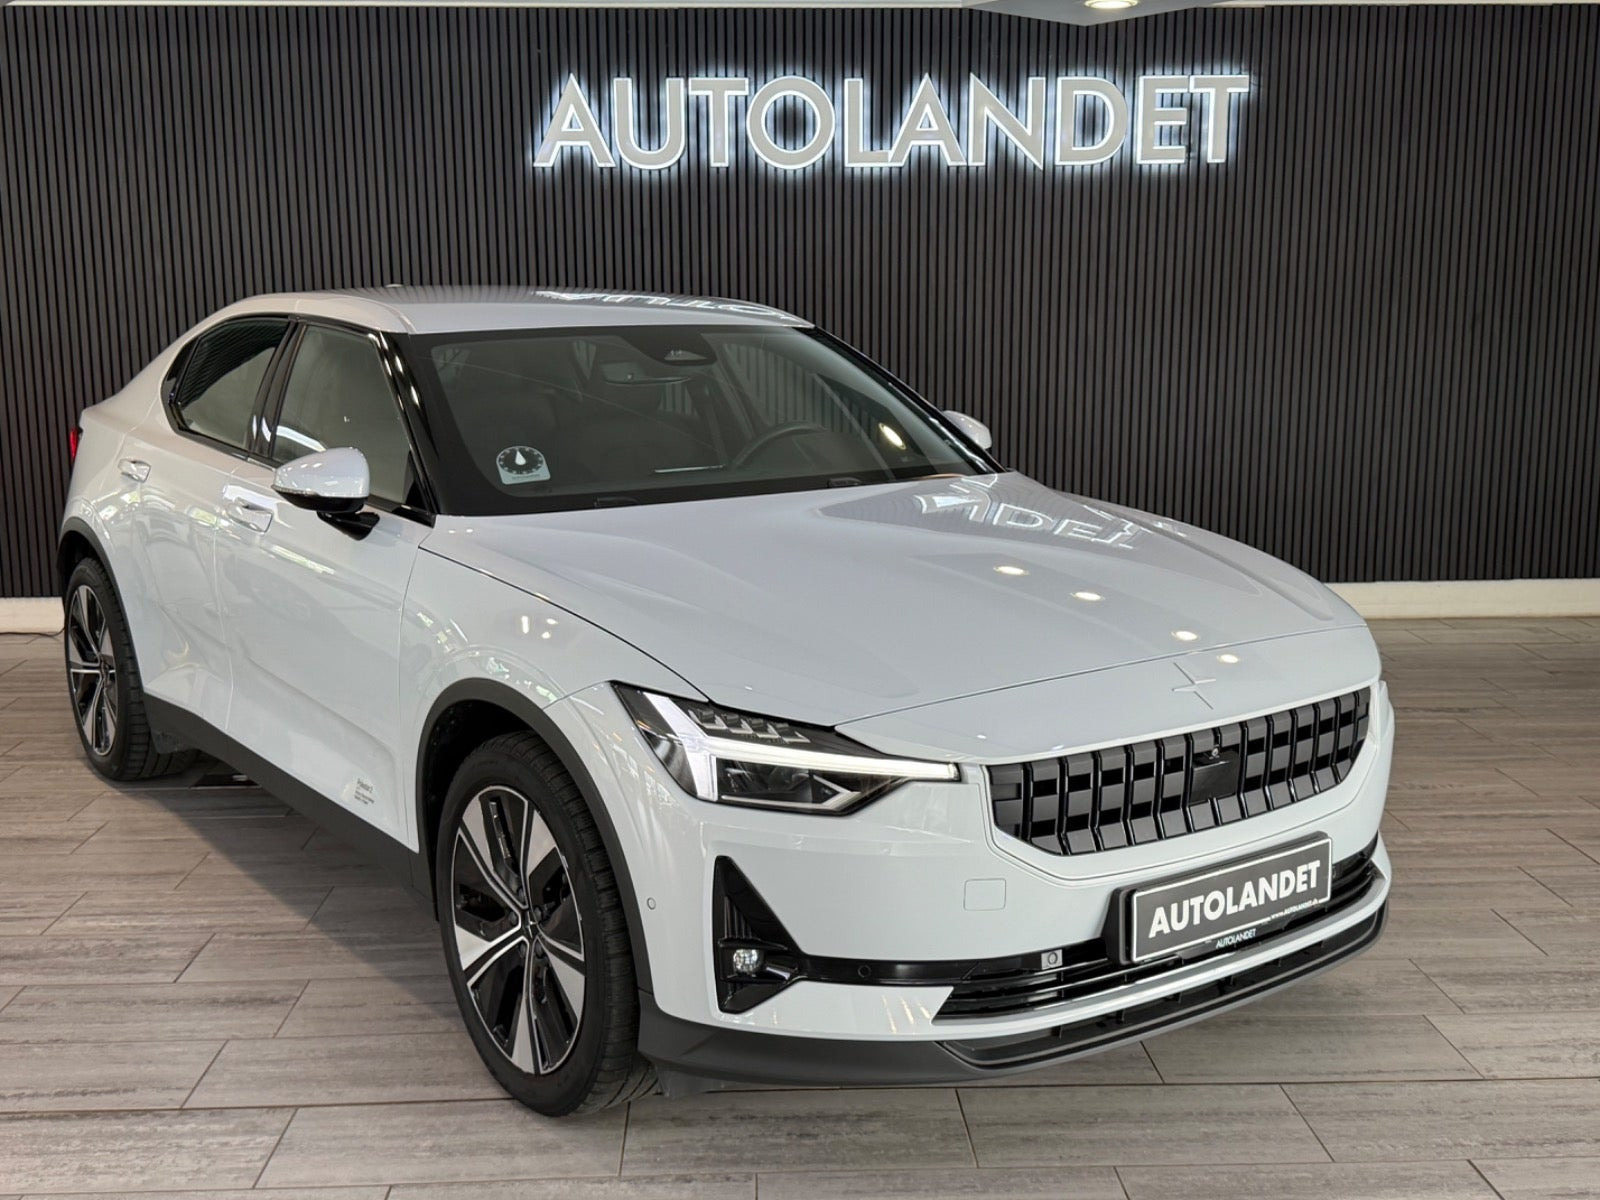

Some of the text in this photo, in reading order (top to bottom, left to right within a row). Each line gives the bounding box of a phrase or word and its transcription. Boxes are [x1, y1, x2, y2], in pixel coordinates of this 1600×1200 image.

[533, 74, 1250, 170] AUTOLANDET
[1148, 860, 1321, 938] AUTOLANDET
[1215, 928, 1257, 949] AUTOLANDET
